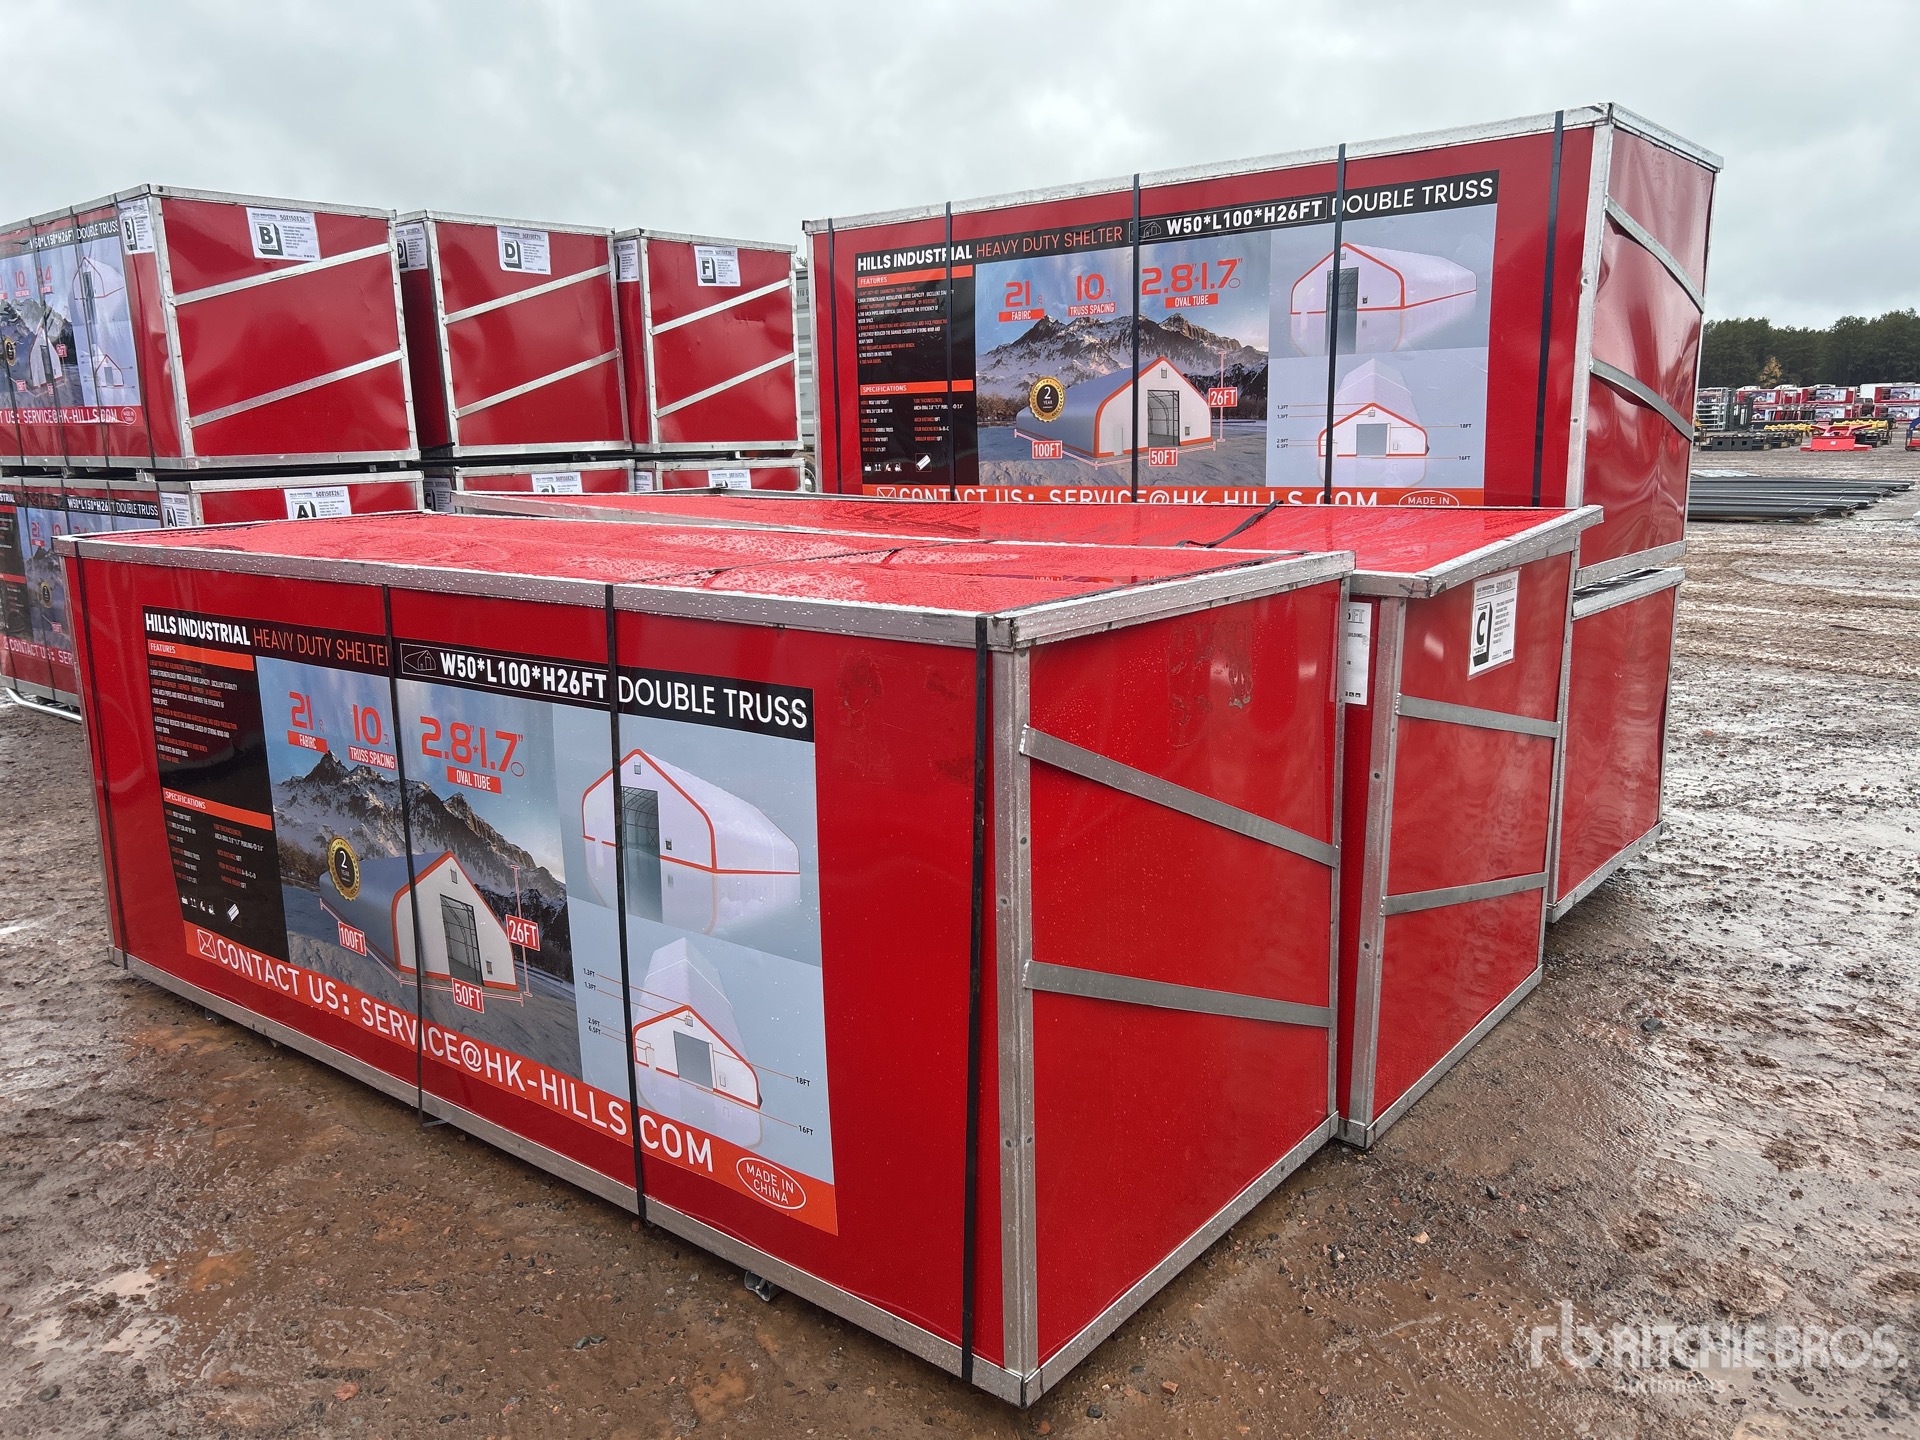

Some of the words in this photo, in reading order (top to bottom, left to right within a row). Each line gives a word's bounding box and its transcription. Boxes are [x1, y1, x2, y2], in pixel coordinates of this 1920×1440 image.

[1332, 188, 1414, 216] DOUBLE
[1421, 177, 1494, 205] TRUSS
[125, 221, 132, 240] B
[258, 225, 274, 245] B
[504, 242, 516, 259] D
[857, 255, 891, 272] HILLS
[893, 244, 973, 268] INDUSTRIAL
[976, 239, 1019, 258] HEAVY
[1022, 234, 1060, 252] DUTY
[1064, 226, 1123, 247] SHELTER
[702, 260, 710, 275] F
[859, 276, 888, 285] FEATURES
[1076, 273, 1105, 302] 10
[1005, 279, 1031, 308] 21
[1174, 296, 1192, 307] OVAL
[1192, 294, 1209, 306] TUBE
[1011, 310, 1032, 321] FABIRC
[1069, 304, 1089, 316] TRUSS
[1089, 303, 1115, 315] SPACING
[862, 384, 907, 393] SPECIFICATIONS
[1044, 386, 1052, 400] 2
[1211, 388, 1236, 406] 26FT
[1034, 443, 1061, 458] 100FT
[1150, 449, 1177, 465] 50FT
[116, 502, 138, 515] DOUBLE
[137, 503, 159, 517] TRUSS
[1407, 496, 1437, 505] MADE
[1440, 496, 1450, 505] IN
[297, 504, 310, 519] A
[144, 612, 177, 636] HILLS
[177, 616, 251, 647] INDUSTRIAL
[253, 627, 293, 651] HEAVY
[296, 634, 333, 658] DUTY
[1476, 611, 1486, 646] C
[149, 642, 176, 655] FEATURES
[289, 690, 314, 731] 21
[618, 674, 716, 717] DOUBLE
[723, 687, 808, 731] TRUSS
[352, 703, 382, 746] 10
[298, 733, 317, 750] FABIRC
[349, 746, 369, 764] TRUSS
[369, 751, 395, 770] SPACING
[456, 769, 473, 787] OVAL
[473, 773, 492, 791] TUBE
[164, 790, 207, 810] SPECIFICATIONS
[339, 850, 348, 869] 2
[340, 926, 364, 954] 100FT
[508, 918, 539, 949] 26FT
[454, 983, 483, 1013] 50FT
[216, 938, 300, 996] CONTACT
[308, 974, 350, 1016] US:
[360, 997, 715, 1174] SERVICE@HK-HILLSCOM
[795, 1075, 811, 1087] 18FT
[798, 1124, 814, 1137] 16FT
[745, 1162, 778, 1187] MADE
[781, 1178, 795, 1194] IN
[753, 1178, 789, 1205] CHINA
